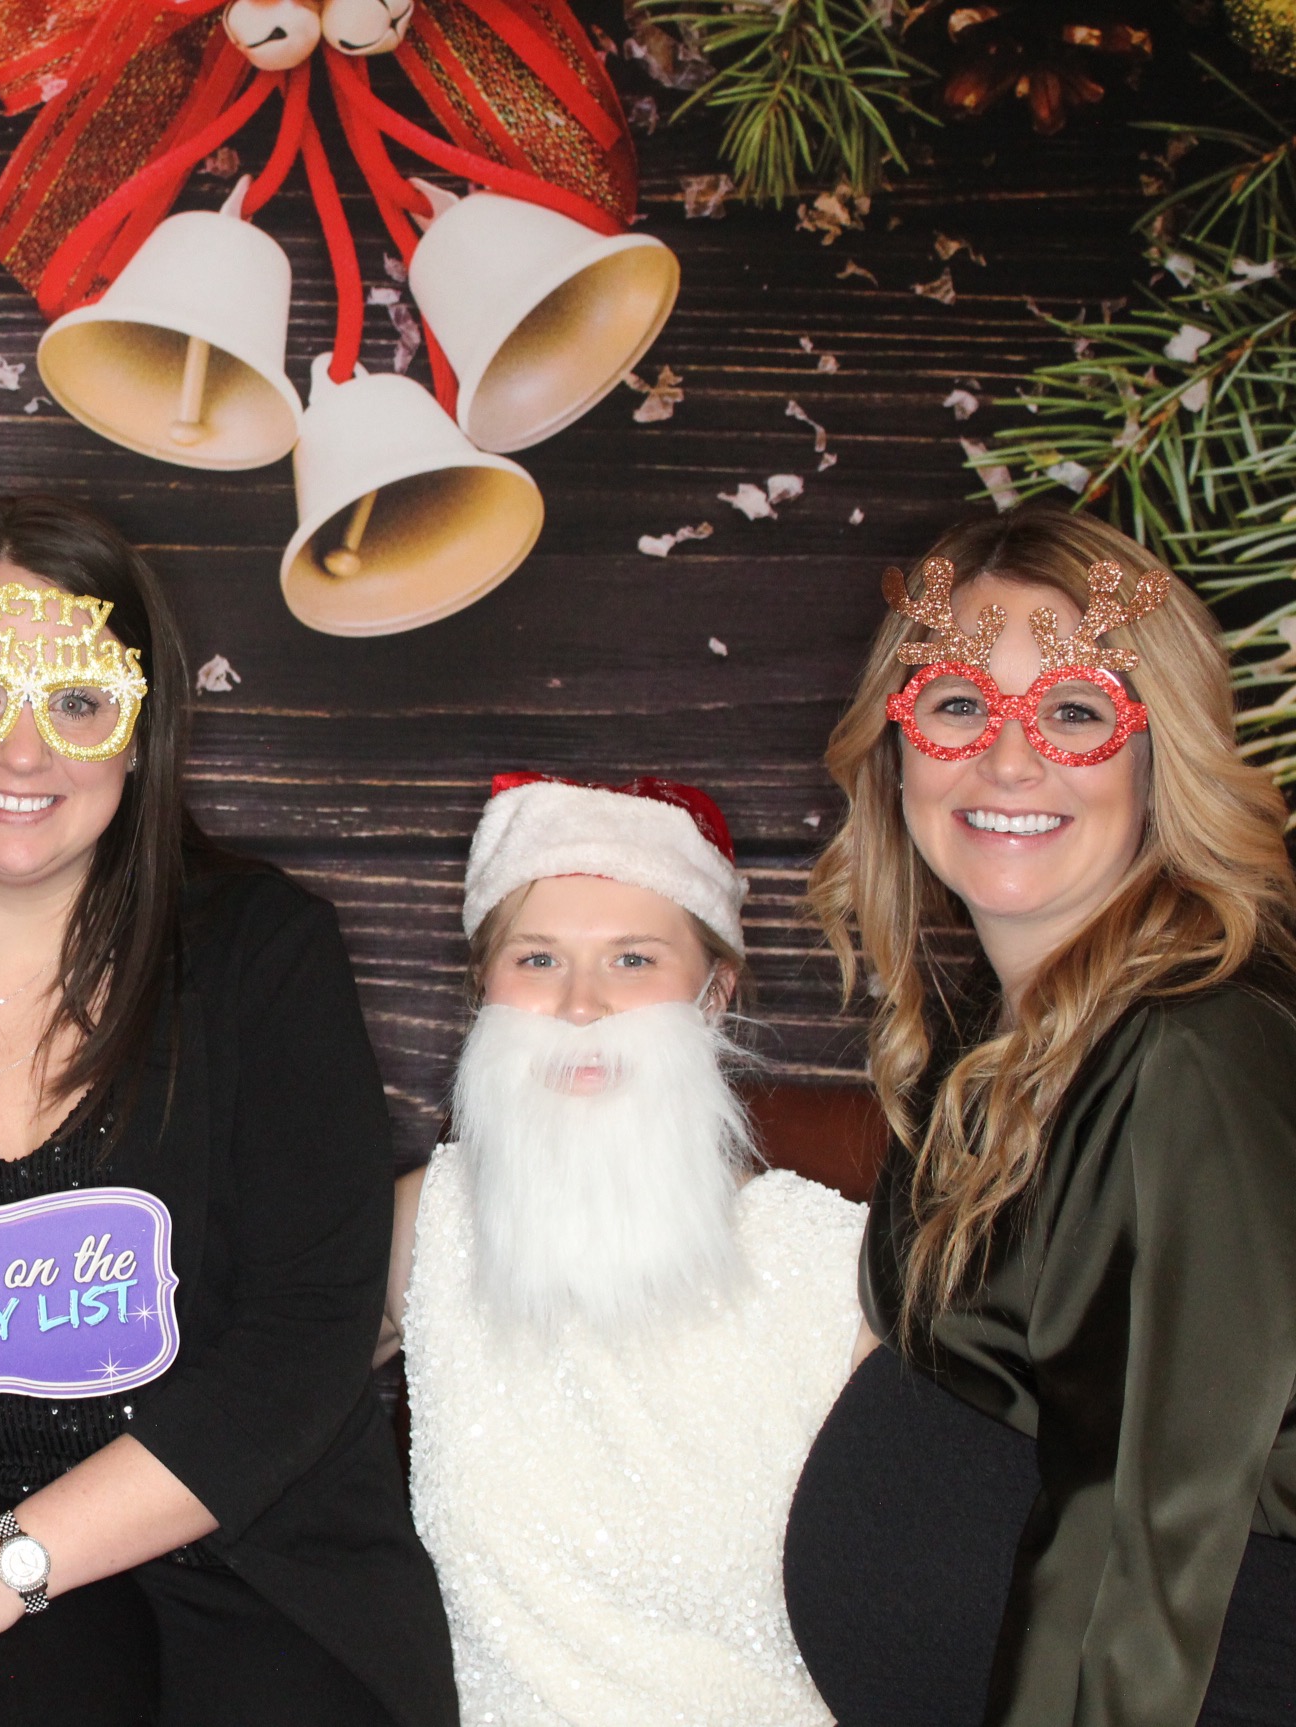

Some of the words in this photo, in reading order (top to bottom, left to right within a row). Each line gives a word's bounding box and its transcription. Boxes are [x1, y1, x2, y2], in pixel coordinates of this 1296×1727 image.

[5, 1257, 60, 1289] on
[72, 1233, 139, 1283] the
[37, 1279, 139, 1333] LIST
